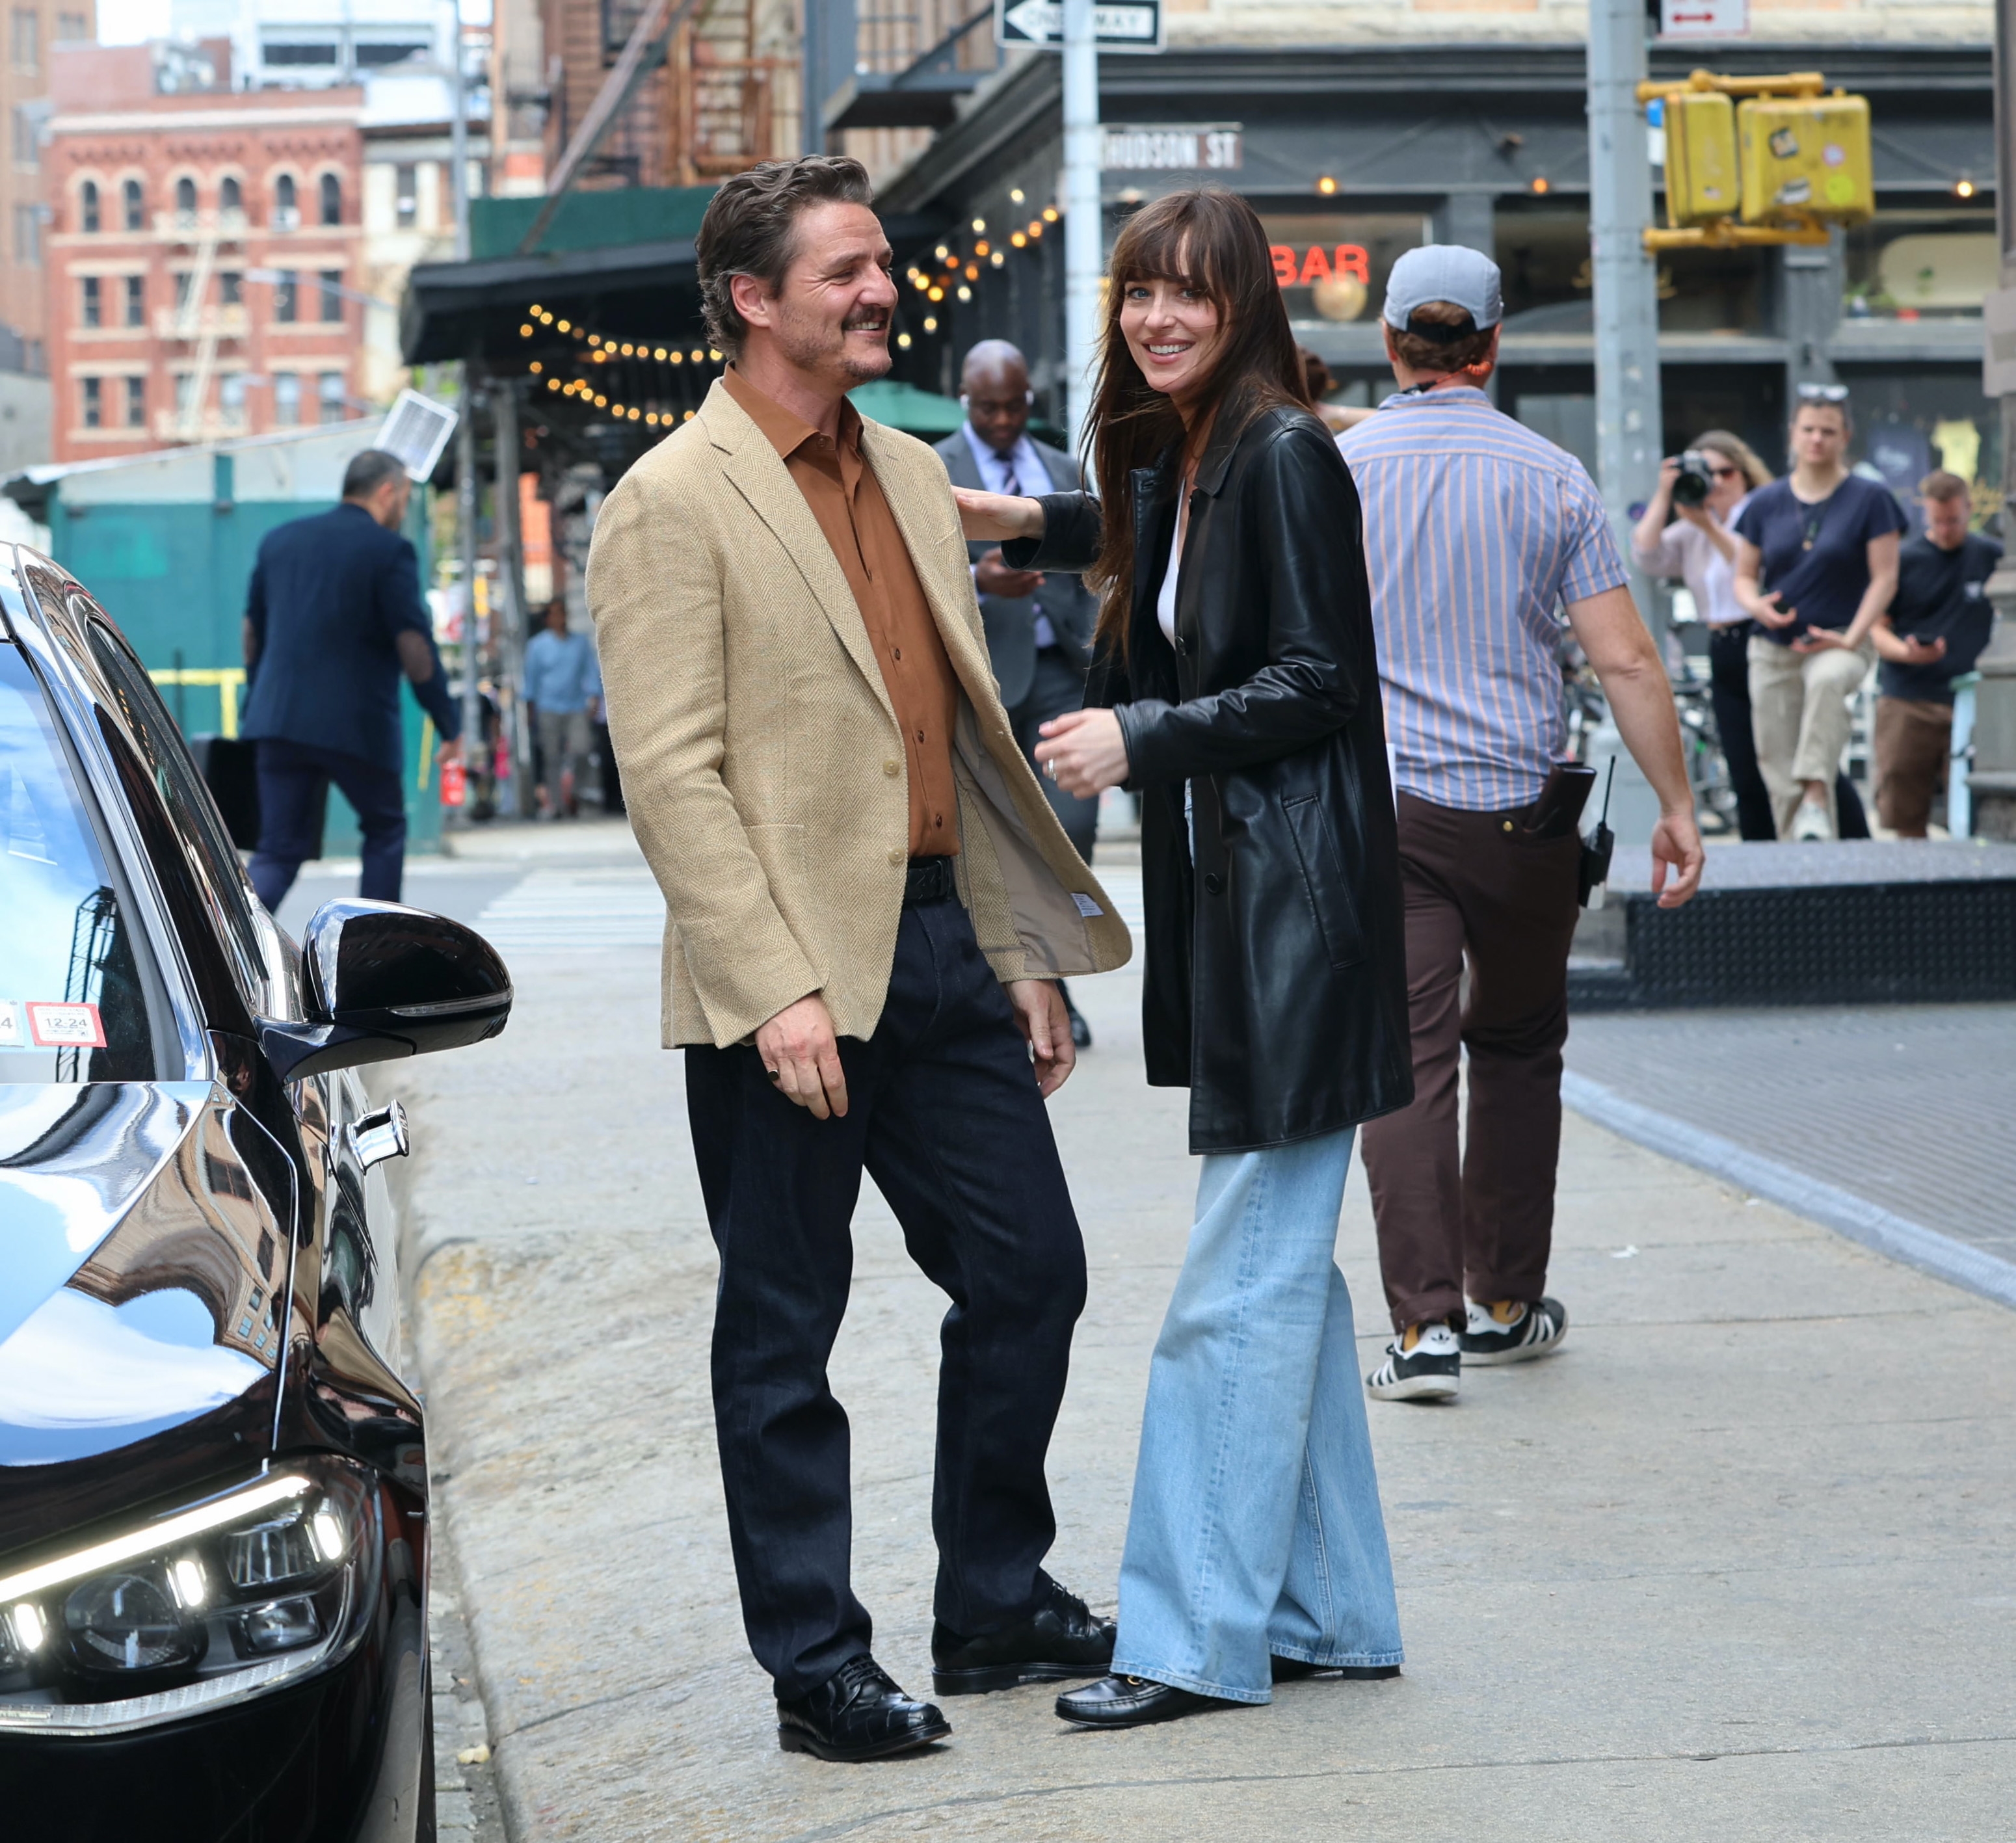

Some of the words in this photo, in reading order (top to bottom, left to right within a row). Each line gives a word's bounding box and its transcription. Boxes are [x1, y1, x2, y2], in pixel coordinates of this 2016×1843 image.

[1107, 133, 1198, 168] HUDSON
[1206, 132, 1236, 168] ST
[1269, 244, 1370, 287] BAR
[44, 1018, 88, 1027] 12-24
